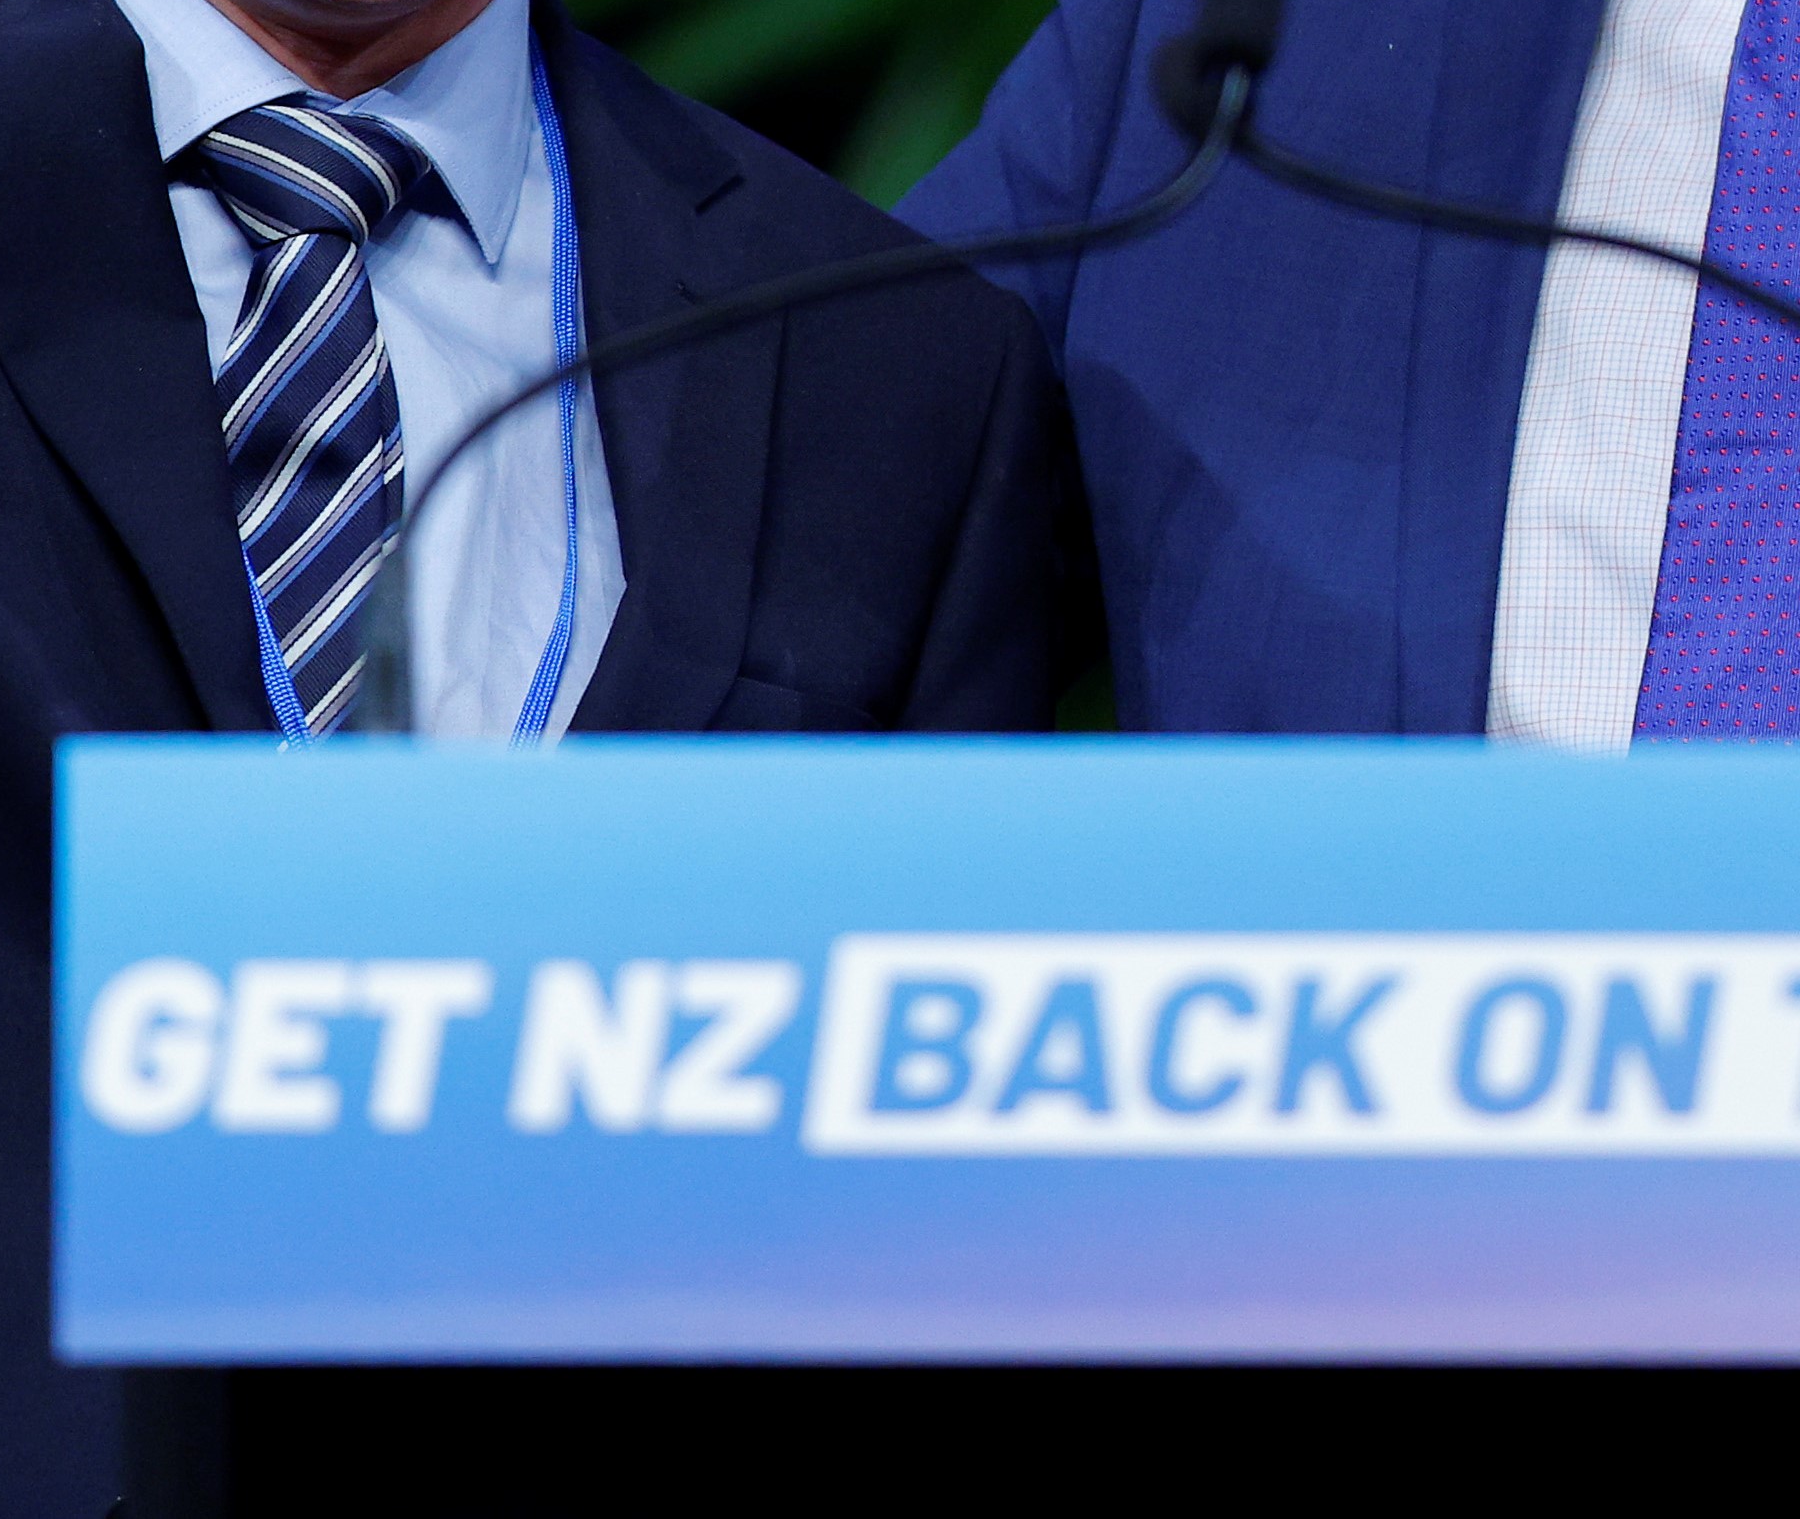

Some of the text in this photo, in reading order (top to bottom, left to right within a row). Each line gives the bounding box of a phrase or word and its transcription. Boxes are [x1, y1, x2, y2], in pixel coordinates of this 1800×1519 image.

[82, 958, 491, 1131] GET
[508, 960, 801, 1132] NZ
[866, 971, 1401, 1116] BACK
[1452, 971, 1716, 1118] ON
